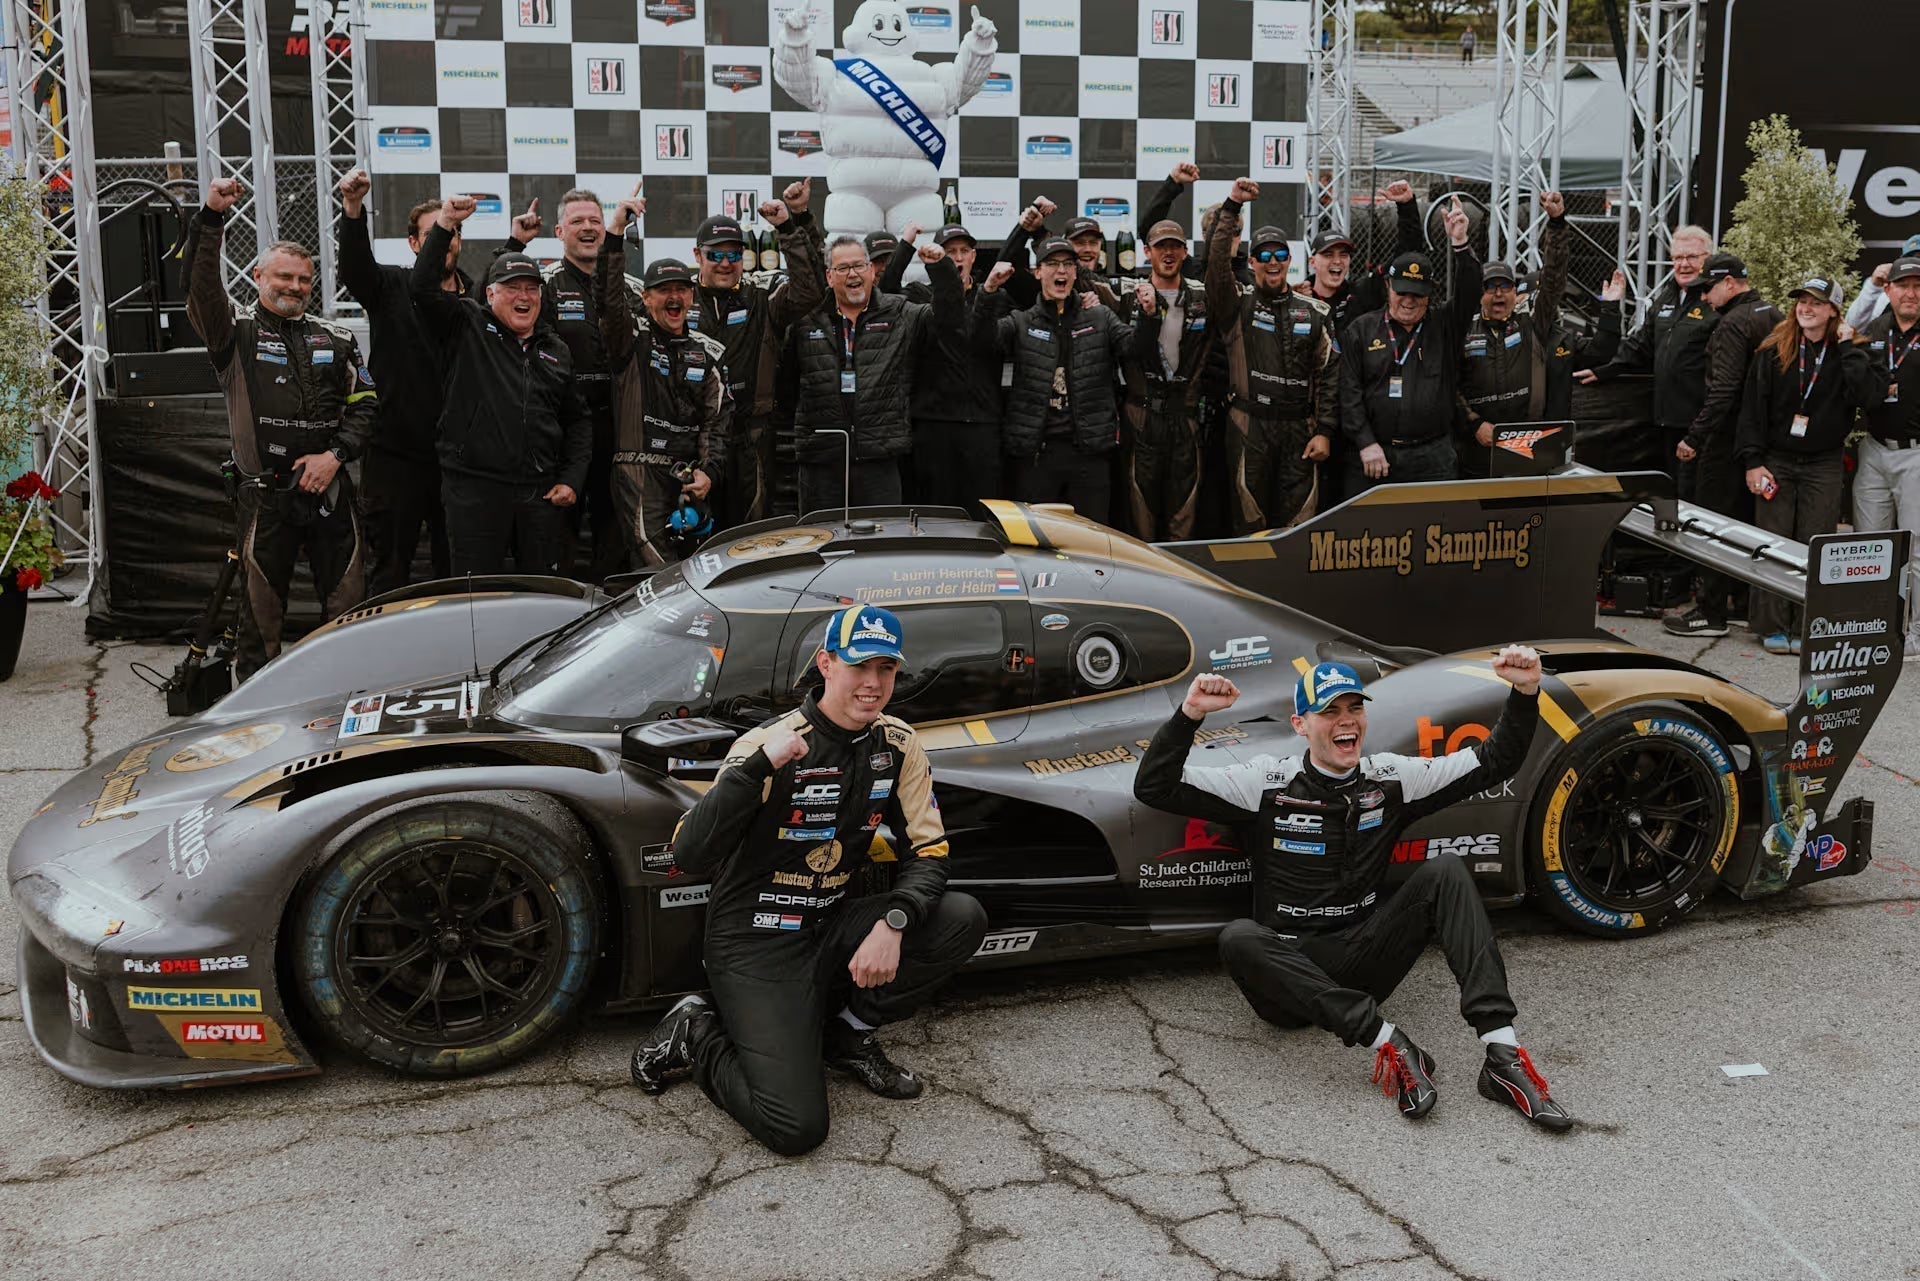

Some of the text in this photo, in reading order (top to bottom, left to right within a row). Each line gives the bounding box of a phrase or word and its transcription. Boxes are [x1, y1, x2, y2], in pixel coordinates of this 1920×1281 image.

[370, 1, 427, 10] MICHELIN
[1025, 19, 1074, 28] MICHELIN
[1154, 13, 1163, 41] IMSA
[443, 69, 499, 79] MICHELIN
[591, 61, 600, 91] IMSA
[1085, 83, 1132, 91] MICHELIN
[1210, 76, 1219, 104] IMSA
[847, 61, 944, 154] MICHELIN
[513, 136, 568, 145] MICHELIN
[659, 128, 668, 157] IMSA
[1266, 139, 1274, 165] IMSA
[260, 416, 339, 430] PORSCHE
[1498, 429, 1543, 440] SPEED
[1503, 439, 1537, 449] SEAT
[1309, 529, 1413, 576] Mustang
[1830, 544, 1883, 556] HYBRID
[893, 568, 994, 583] Laurin Heinrich
[1846, 565, 1881, 577] BOSCH
[855, 580, 995, 603] Tijmen van der Helm
[1827, 618, 1887, 635] Multimatic
[852, 632, 897, 644] MICHELIN
[1209, 635, 1270, 660] JDC
[1810, 641, 1873, 671] wiha
[1212, 659, 1273, 671] MOTORSPORTS
[1316, 679, 1355, 694] MICHELIN
[1831, 684, 1875, 701] HEXAGON
[1813, 708, 1861, 721] PRODUCTIVITY
[1813, 716, 1861, 732] QUALITY INC
[888, 731, 906, 743] OMP
[1664, 721, 1727, 768] MICHELIN
[1022, 744, 1139, 777] Mustang
[1563, 774, 1574, 791] M
[791, 784, 841, 799] JDC
[1274, 813, 1323, 827] JDC
[1287, 844, 1321, 852] MICHELIN
[1806, 834, 1835, 871] VP
[1139, 857, 1252, 878] St. Jude Children's
[772, 870, 815, 890] Mustang
[1139, 872, 1252, 889] Research Hospital
[665, 889, 711, 903] Weat
[1555, 878, 1619, 926] MICHELIN
[753, 914, 780, 926] OMP
[981, 935, 1031, 951] GTP
[132, 990, 257, 1007] MICHELIN
[187, 1023, 263, 1041] MOTUL
